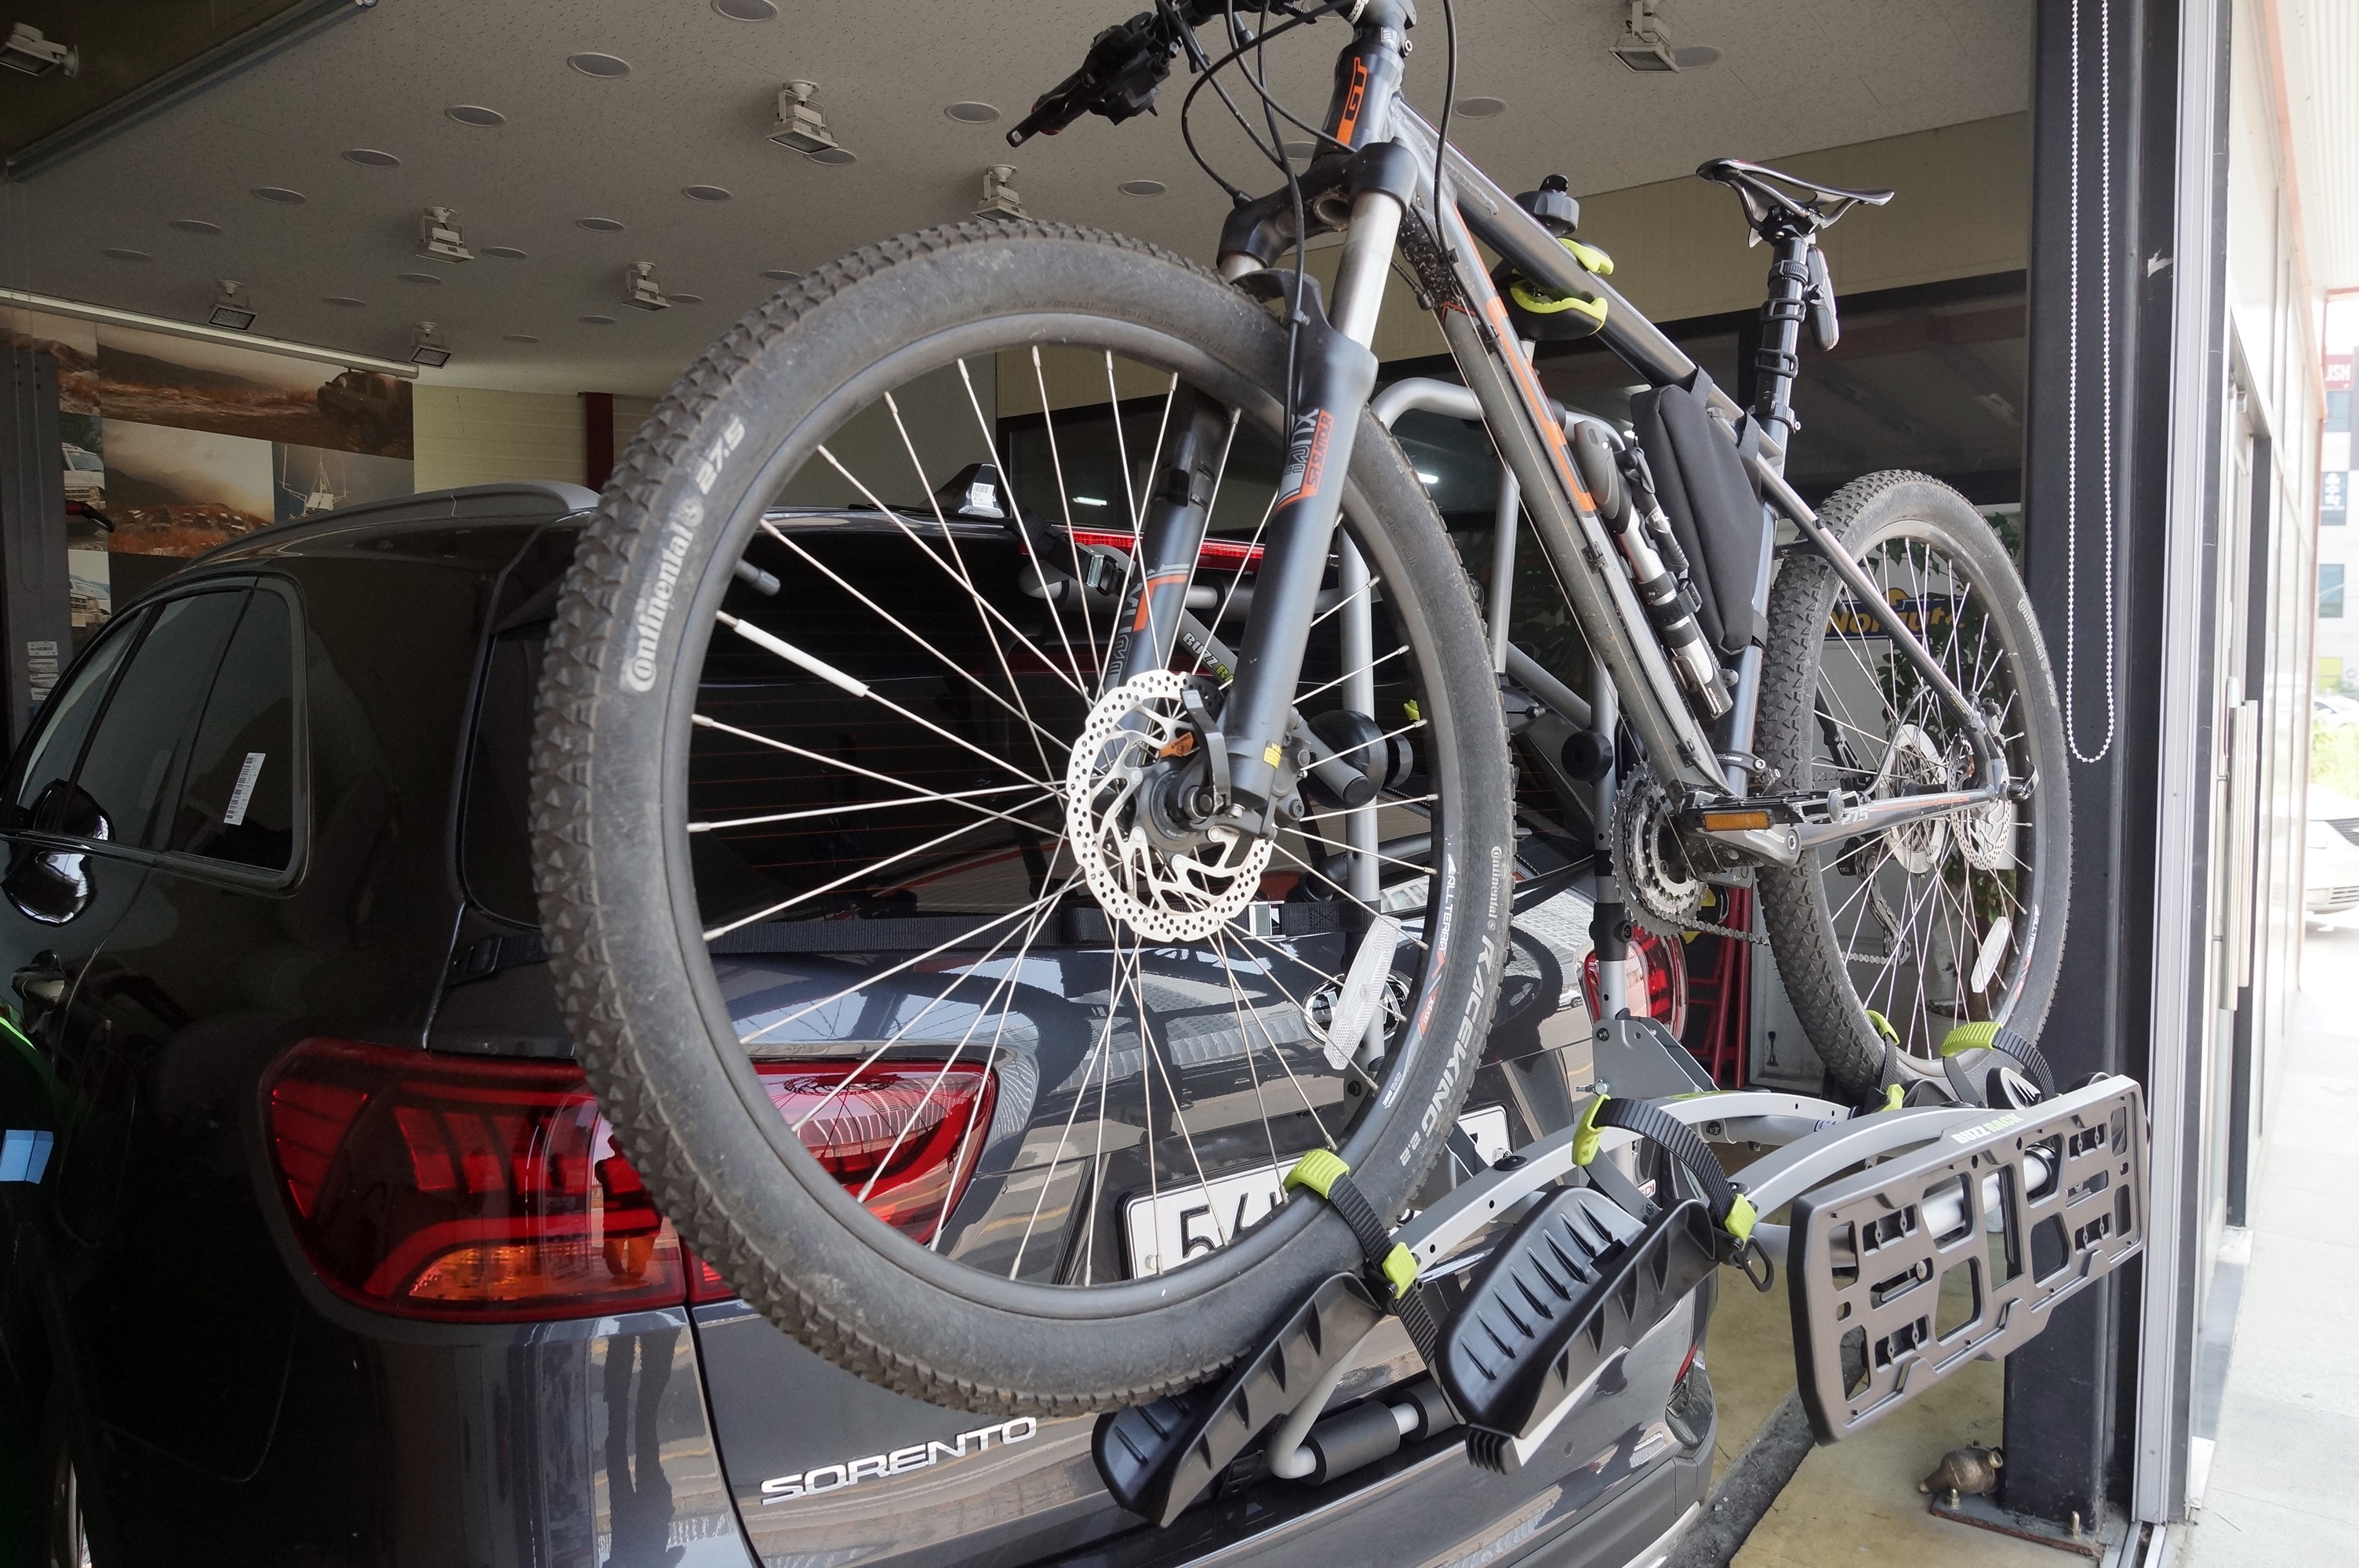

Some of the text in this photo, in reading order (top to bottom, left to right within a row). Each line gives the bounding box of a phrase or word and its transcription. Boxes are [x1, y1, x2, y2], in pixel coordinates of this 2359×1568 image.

[627, 416, 746, 692] Continental 27.5
[1182, 632, 1219, 669] BUZZ
[2017, 598, 2048, 661] Continental
[1488, 845, 1503, 919] Continental
[1950, 1112, 2024, 1144] BUZZ RACK
[760, 1416, 1037, 1506] SORENTO
